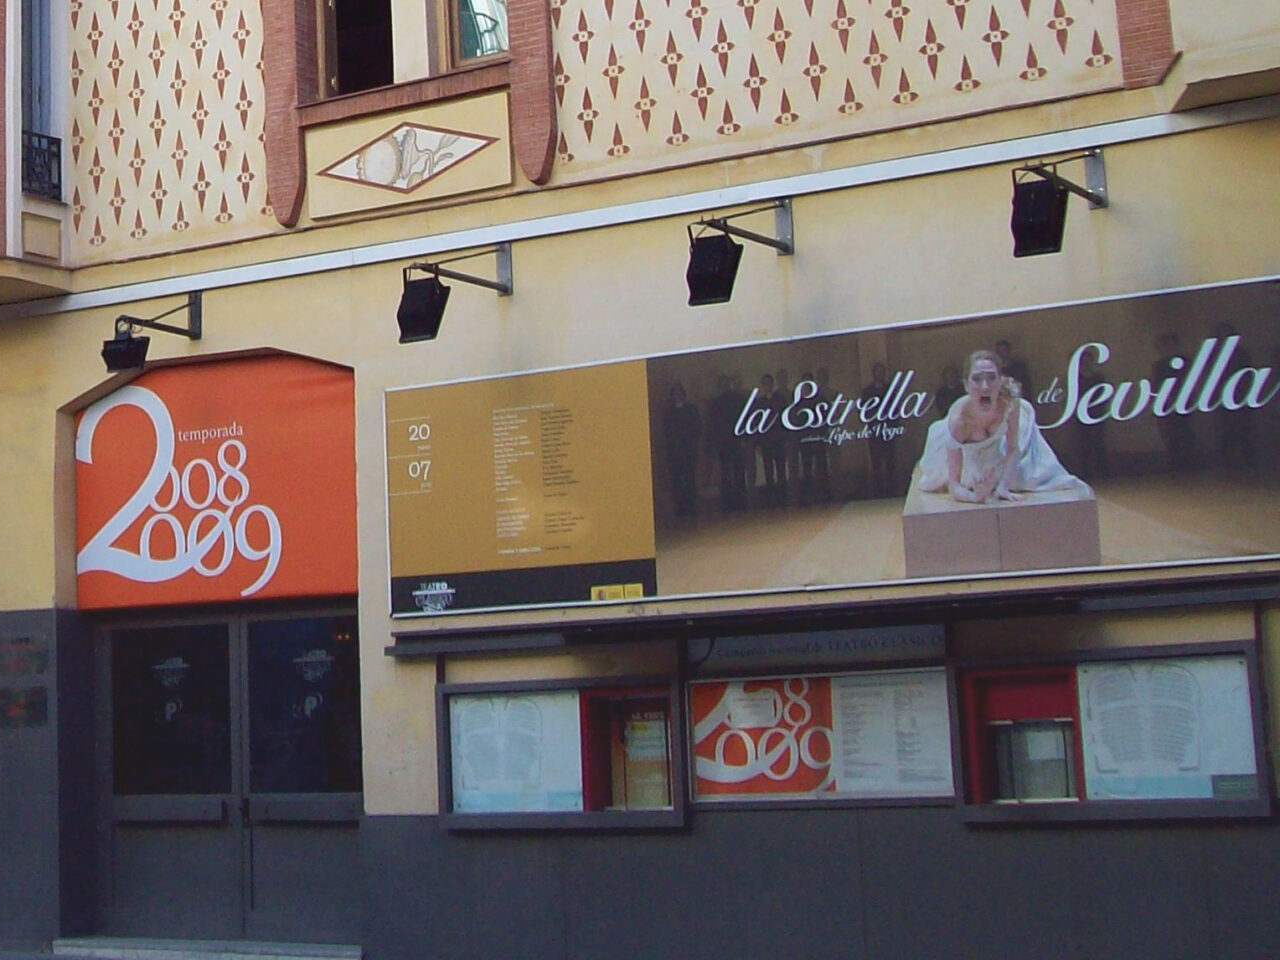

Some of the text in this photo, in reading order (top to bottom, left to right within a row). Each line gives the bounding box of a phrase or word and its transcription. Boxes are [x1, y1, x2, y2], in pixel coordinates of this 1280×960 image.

[734, 335, 1278, 436] la Estrella de Sevilla
[178, 421, 244, 444] temporada
[408, 424, 430, 441] 20
[408, 461, 431, 480] 07
